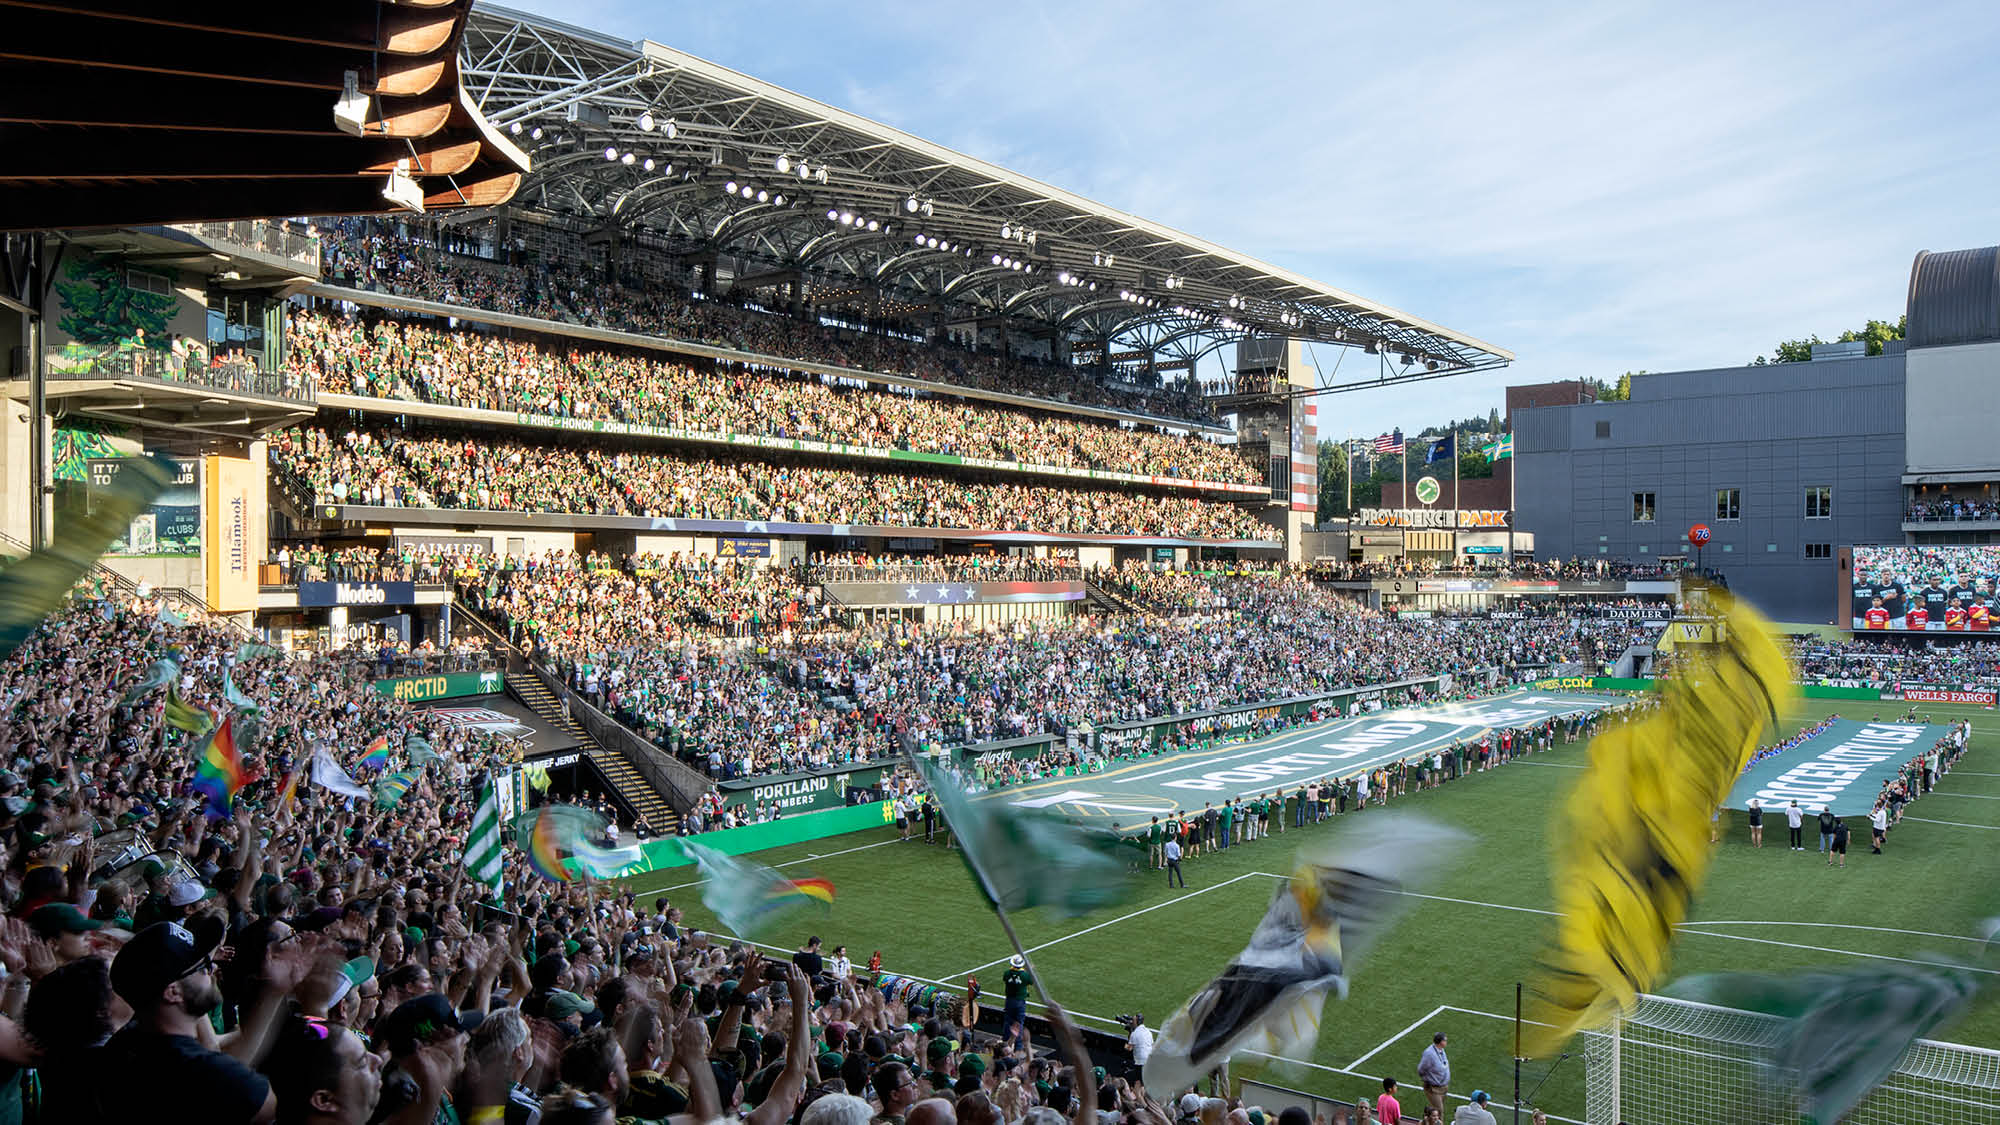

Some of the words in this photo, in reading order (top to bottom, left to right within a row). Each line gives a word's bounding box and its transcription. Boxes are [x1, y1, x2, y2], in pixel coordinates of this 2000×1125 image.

[530, 414, 554, 426] RING
[561, 418, 594, 431] HONOR
[600, 422, 627, 433] JOHN
[686, 429, 728, 441] CHARLES
[761, 437, 794, 448] CONWAY
[93, 464, 104, 474] IT
[93, 474, 112, 485] TO
[1359, 508, 1456, 527] PROVIDENCE
[1459, 509, 1508, 528] PARK
[167, 524, 194, 535] CLUBS
[231, 496, 241, 574] Tillamook
[1696, 528, 1711, 540] 76
[336, 583, 386, 603] Modelo
[1610, 609, 1662, 619] DAIMLER
[1680, 624, 1705, 640] W
[394, 677, 447, 699] #RCTID
[1906, 691, 1948, 701] WELLS
[1951, 692, 1993, 703] FARGO
[1851, 723, 1927, 744] USA
[975, 748, 1012, 765] Alaska
[1160, 722, 1428, 791] PORTLAND
[1817, 741, 1904, 762] CITY
[555, 753, 580, 767] JERKY
[753, 776, 829, 801] PORTLAND
[1745, 762, 1874, 811] SOCCER
